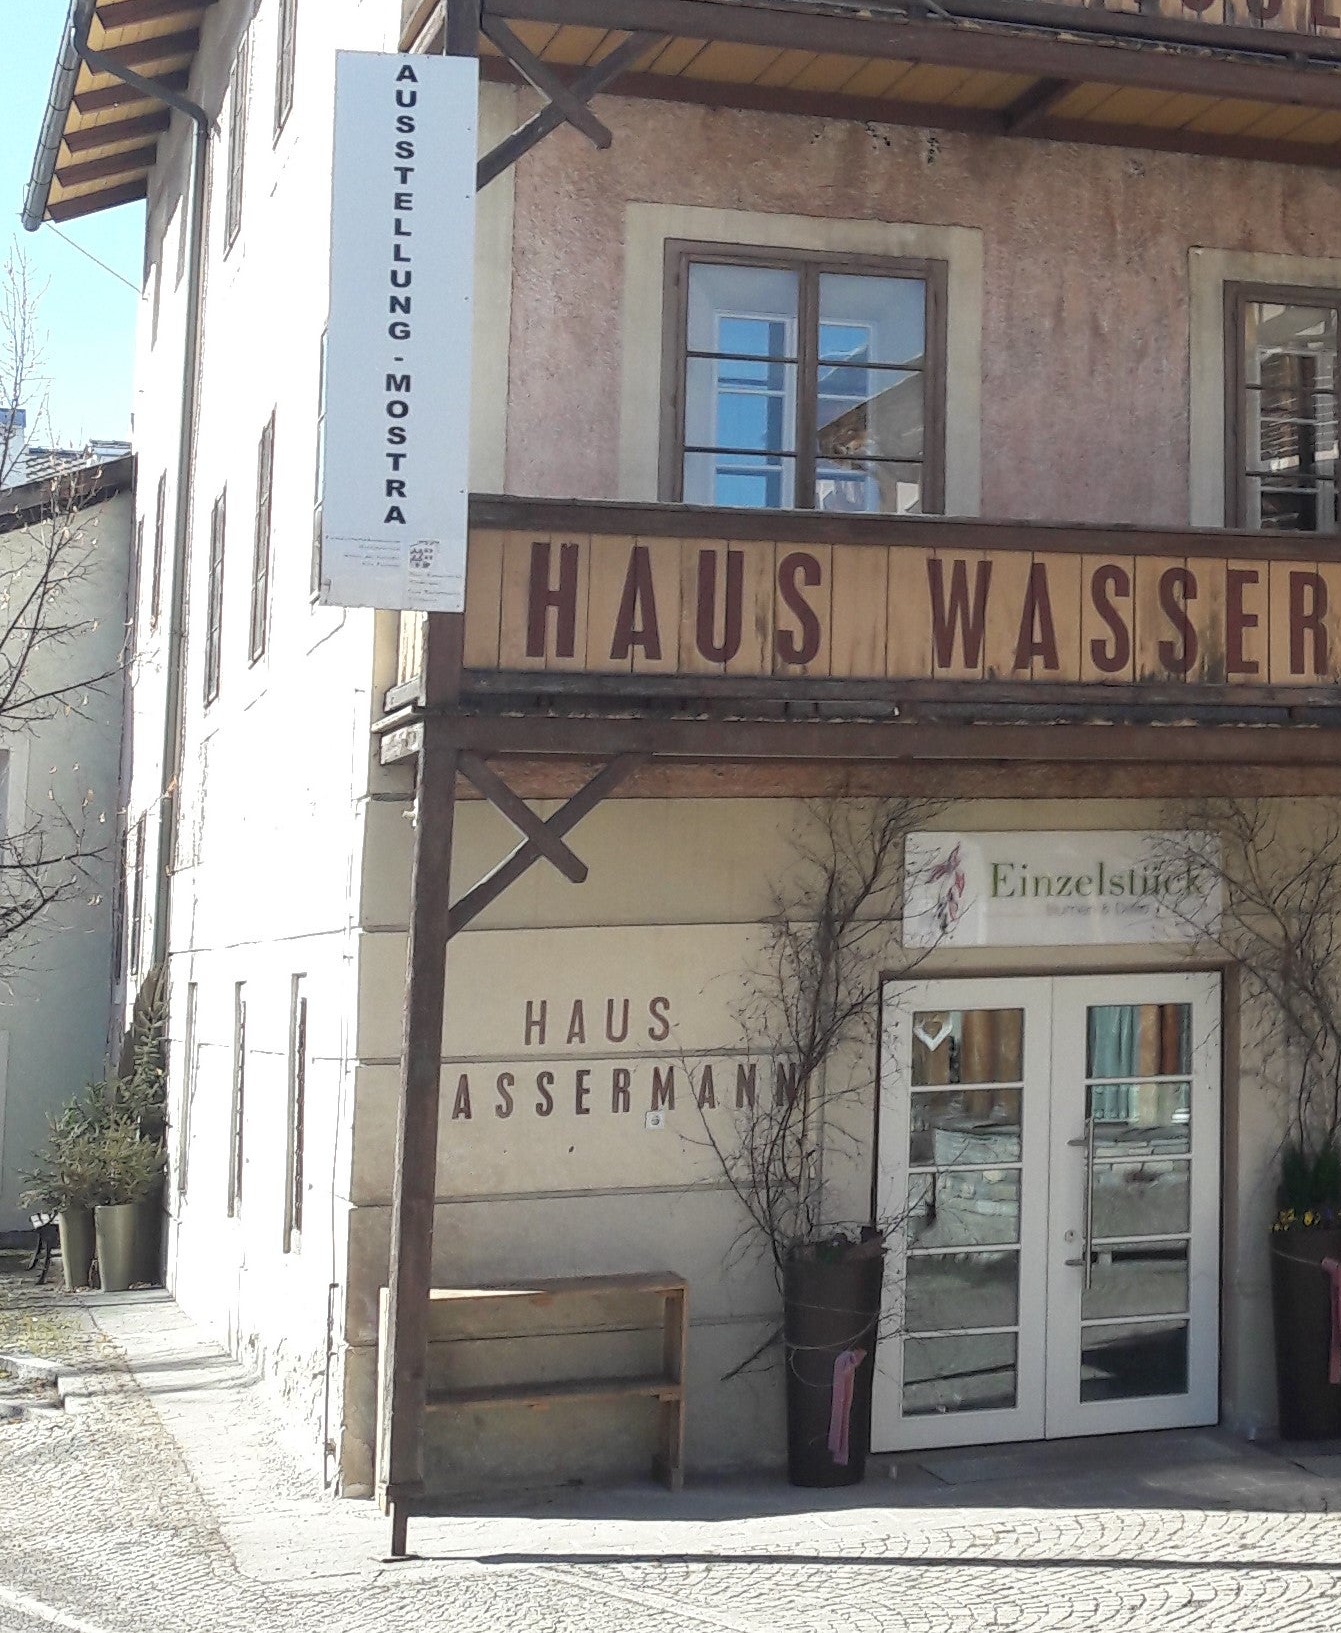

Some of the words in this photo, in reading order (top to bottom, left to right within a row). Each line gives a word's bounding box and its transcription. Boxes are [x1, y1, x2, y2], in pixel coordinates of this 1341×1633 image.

[525, 540, 823, 666] HAUS
[990, 861, 1206, 899] Einzelstück
[524, 996, 671, 1046] HAUS
[451, 1062, 797, 1120] ASSERMANN
